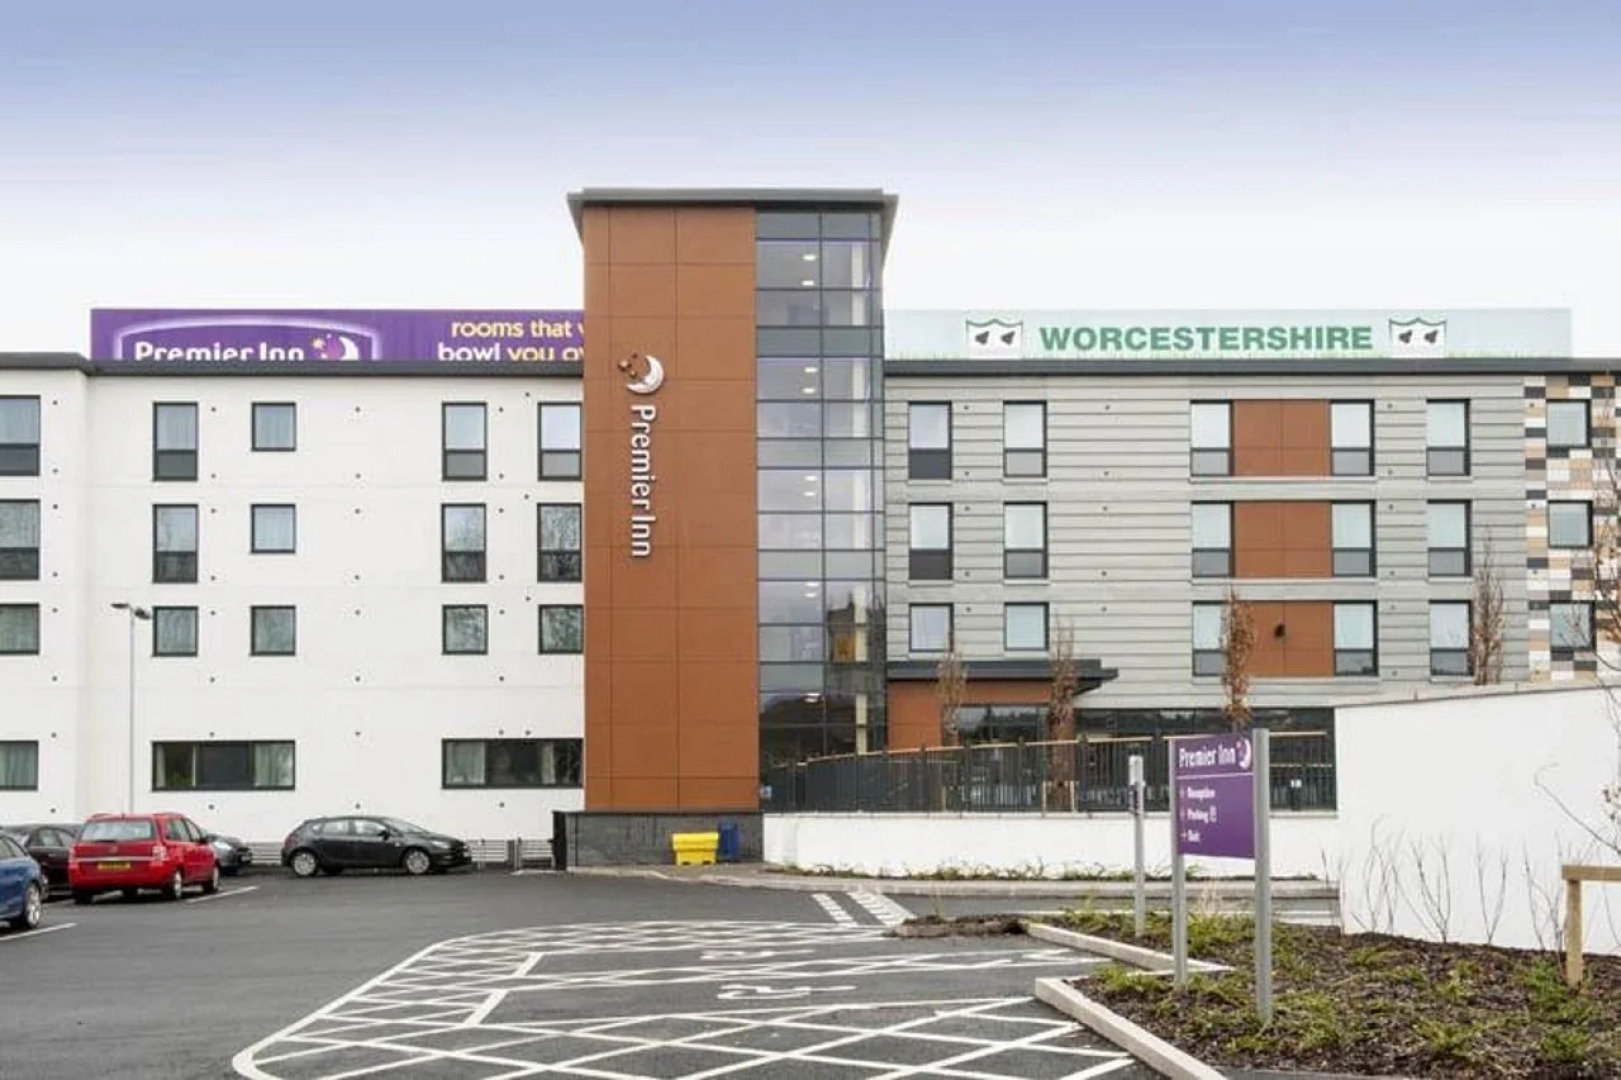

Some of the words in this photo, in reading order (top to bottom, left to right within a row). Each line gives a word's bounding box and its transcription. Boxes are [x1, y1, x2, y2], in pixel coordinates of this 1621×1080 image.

[451, 321, 524, 337] rooms
[530, 319, 573, 337] that
[1040, 327, 1373, 350] WORCESTERSHIRE
[134, 341, 254, 361] Premier
[259, 342, 304, 361] Inn
[437, 342, 500, 361] bowl
[631, 404, 657, 510] Premier
[631, 516, 656, 557] Inn
[1179, 745, 1217, 768] Premier
[1218, 744, 1236, 765] Inn
